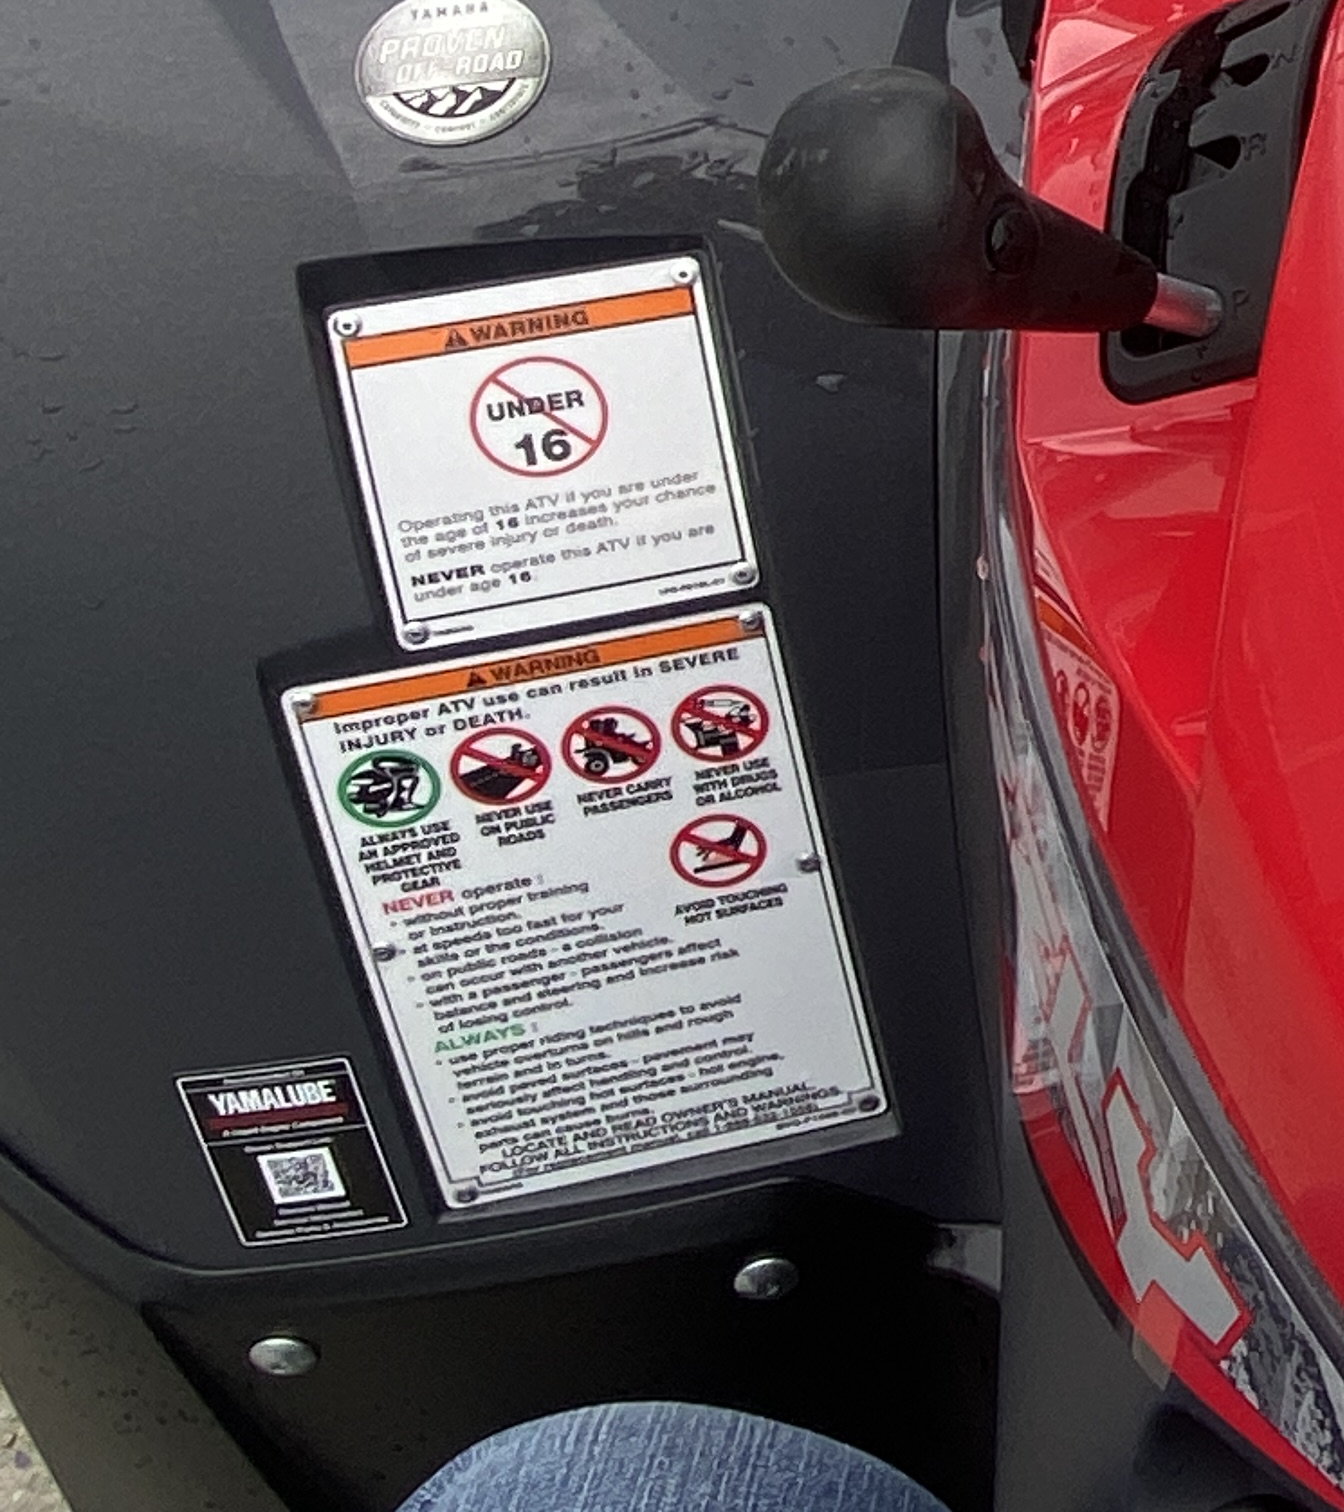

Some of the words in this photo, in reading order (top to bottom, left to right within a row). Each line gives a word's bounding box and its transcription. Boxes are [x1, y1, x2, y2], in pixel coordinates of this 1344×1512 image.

[411, 1, 489, 21] YAMAHA
[379, 25, 506, 65] PROVEN
[469, 309, 590, 343] WARNING
[485, 388, 585, 422] UNDER
[513, 426, 573, 468] 16
[397, 506, 485, 538] Operating
[488, 500, 520, 518] this
[523, 493, 561, 511] ATV
[564, 490, 576, 504] if
[580, 486, 613, 505] you
[617, 480, 645, 495] are
[649, 469, 699, 489] under
[400, 532, 429, 549] the
[434, 527, 468, 547] age
[471, 522, 489, 536] of
[495, 517, 519, 531] 16
[524, 500, 608, 527] increases
[612, 495, 651, 515] your
[653, 480, 717, 504] chance
[404, 549, 422, 564] of
[426, 539, 486, 560] severe
[489, 528, 538, 552] injury
[542, 526, 560, 539] or
[565, 513, 618, 535] death.
[411, 563, 485, 588] NEVER
[489, 552, 556, 577] operate
[560, 544, 592, 561] this
[595, 537, 631, 555] ATV
[635, 534, 647, 547] if
[651, 530, 683, 548] you
[687, 523, 715, 538] are
[413, 582, 463, 603] under
[469, 576, 502, 596] age
[490, 648, 602, 683] WARNING
[332, 705, 432, 736] Improper
[434, 696, 478, 717] ATV
[482, 690, 520, 708] use
[525, 682, 563, 699] can
[567, 668, 628, 691] result
[632, 663, 654, 679] in
[657, 646, 741, 674] SEVERE
[338, 726, 417, 753] INJURY
[423, 723, 448, 737] or
[451, 705, 531, 732] DEATH.
[380, 888, 455, 915] NEVER
[459, 874, 534, 901] operate
[431, 1022, 526, 1054] ALWAYS
[208, 1079, 337, 1116] YAMALUBE
